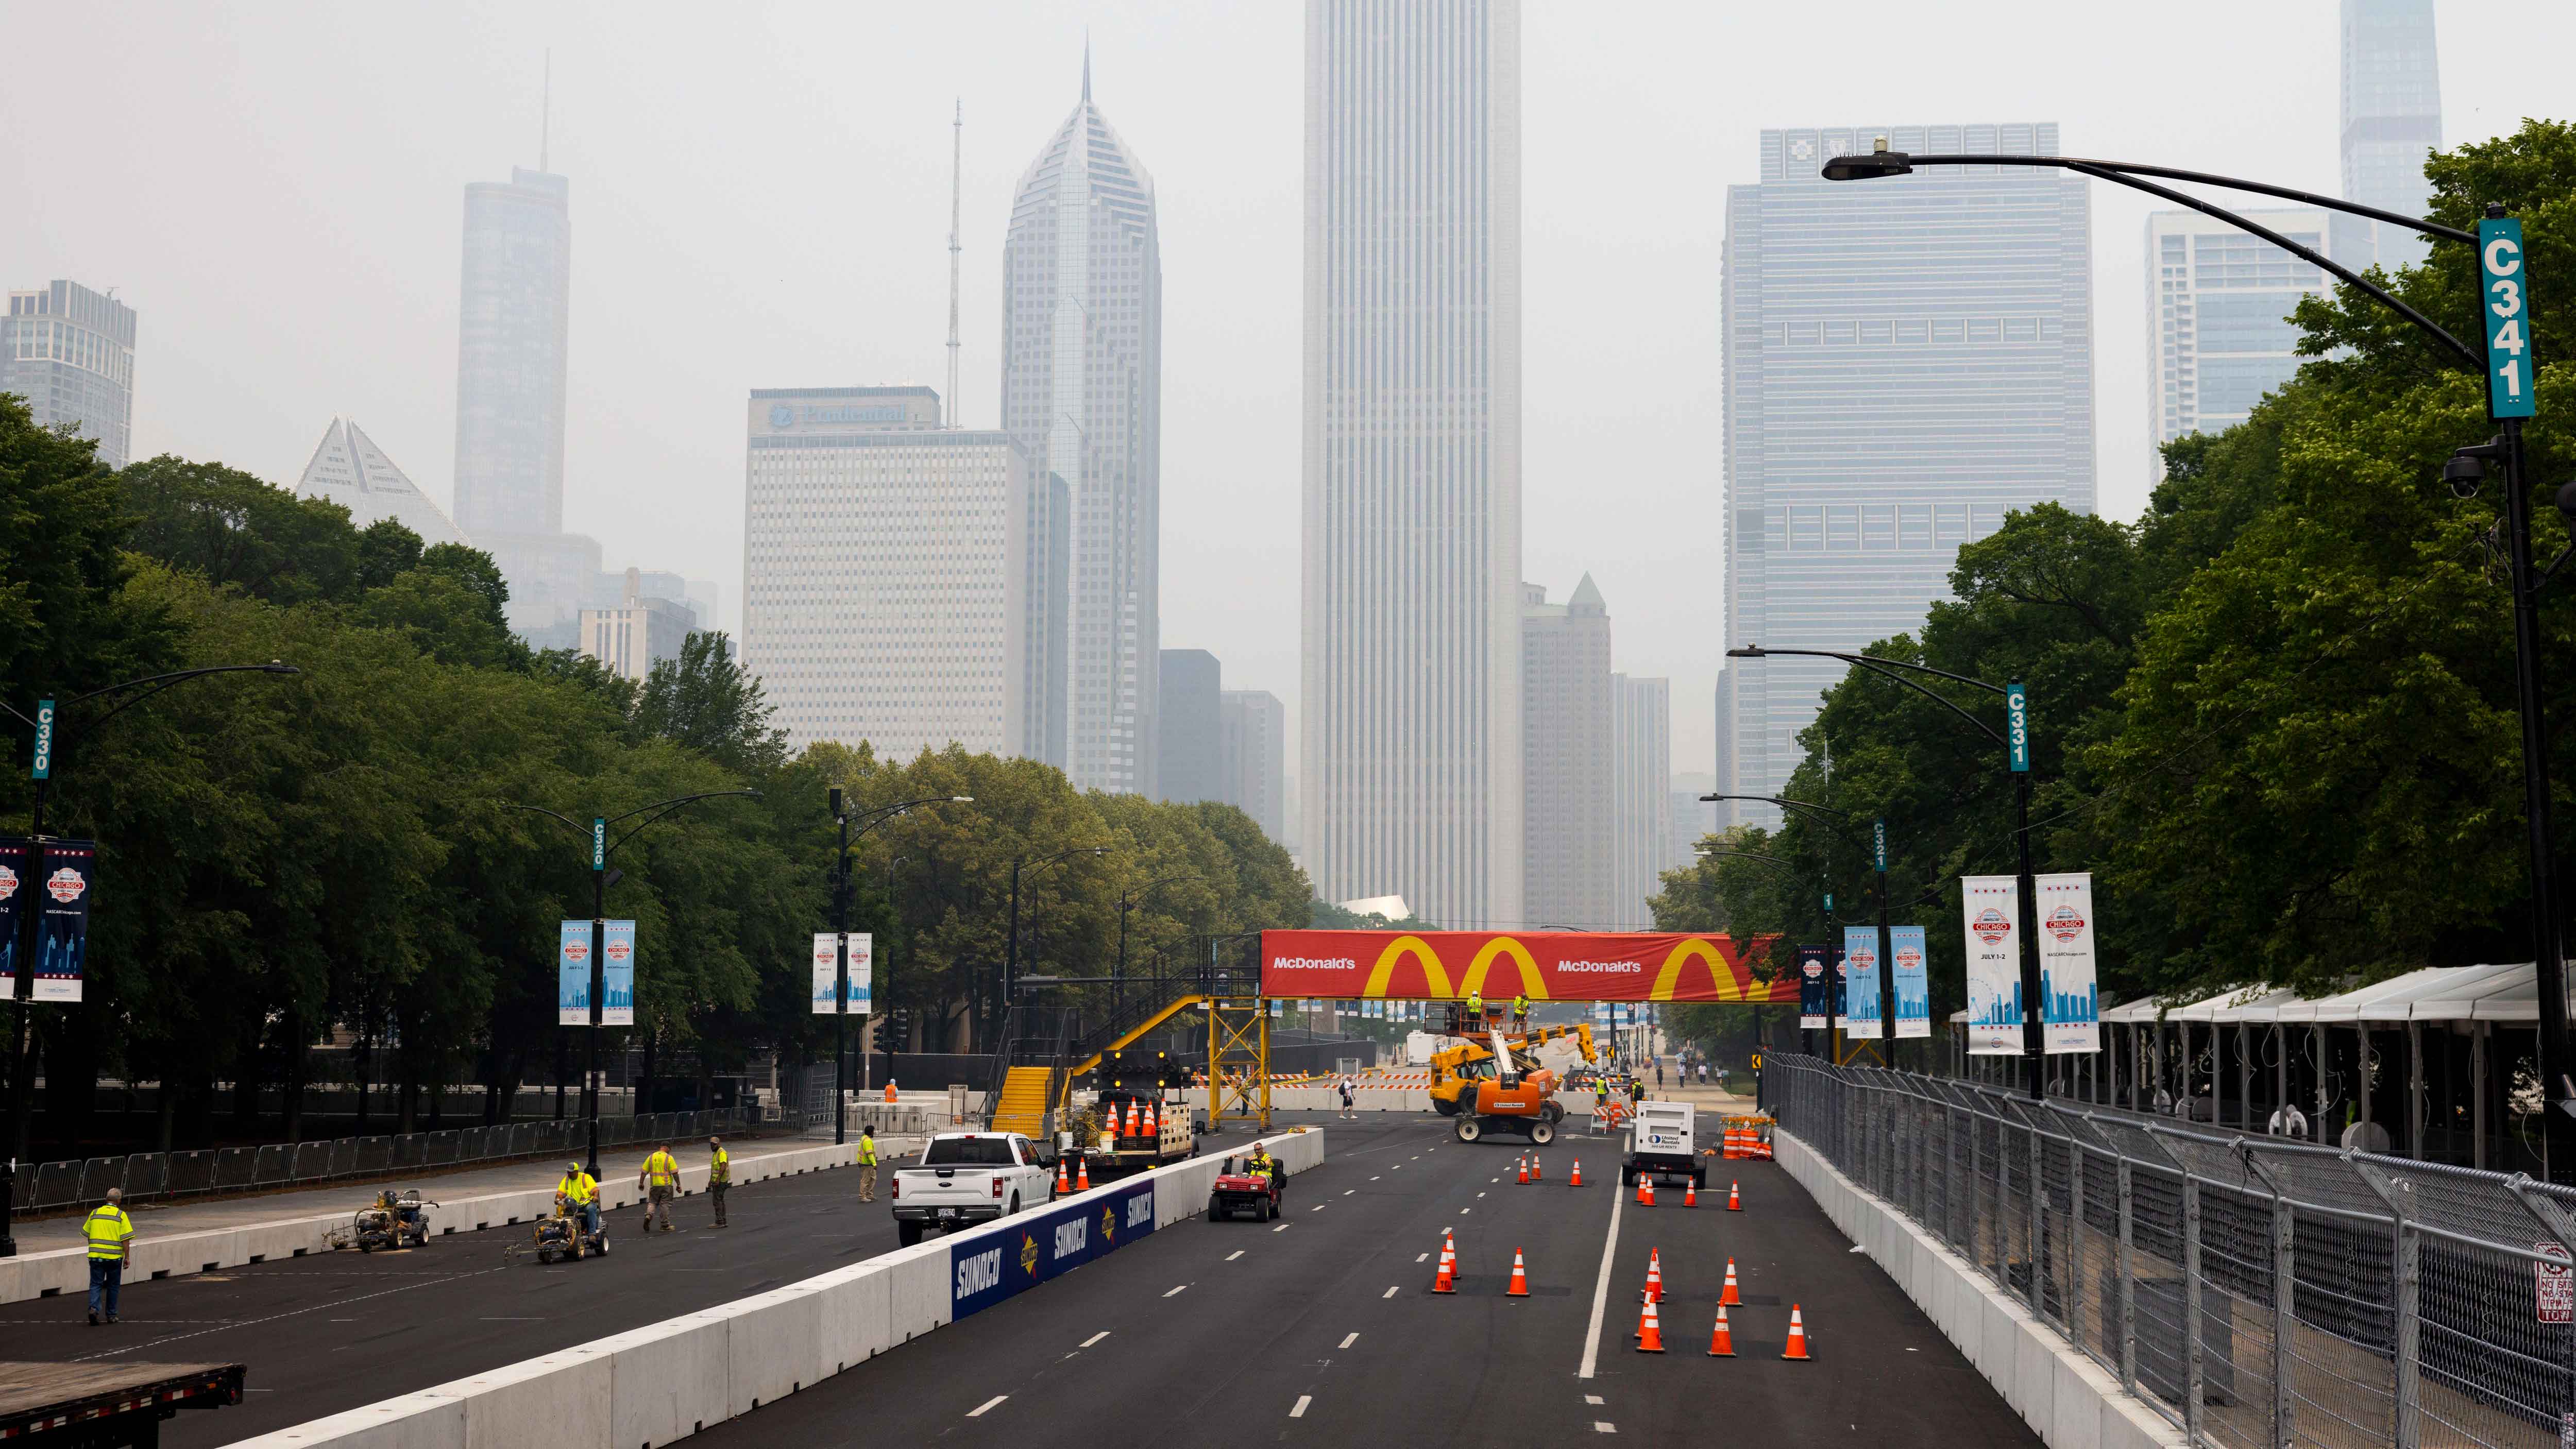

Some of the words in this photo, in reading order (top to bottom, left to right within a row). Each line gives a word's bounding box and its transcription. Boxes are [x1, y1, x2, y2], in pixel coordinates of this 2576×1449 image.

[2484, 238, 2524, 396] C341
[803, 403, 906, 421] Prudential
[36, 708, 52, 771] C330
[2009, 693, 2025, 762] C331
[595, 824, 603, 865] C320
[1874, 823, 1885, 866] C321
[1274, 957, 1355, 969] McDonald's
[1558, 961, 1641, 973] McDonald's
[1127, 1191, 1152, 1228] SUNOCO
[1022, 1245, 1038, 1267] SUNOCO
[1055, 1216, 1087, 1260] SUNOCO
[957, 1248, 1001, 1300] SUNOCO
